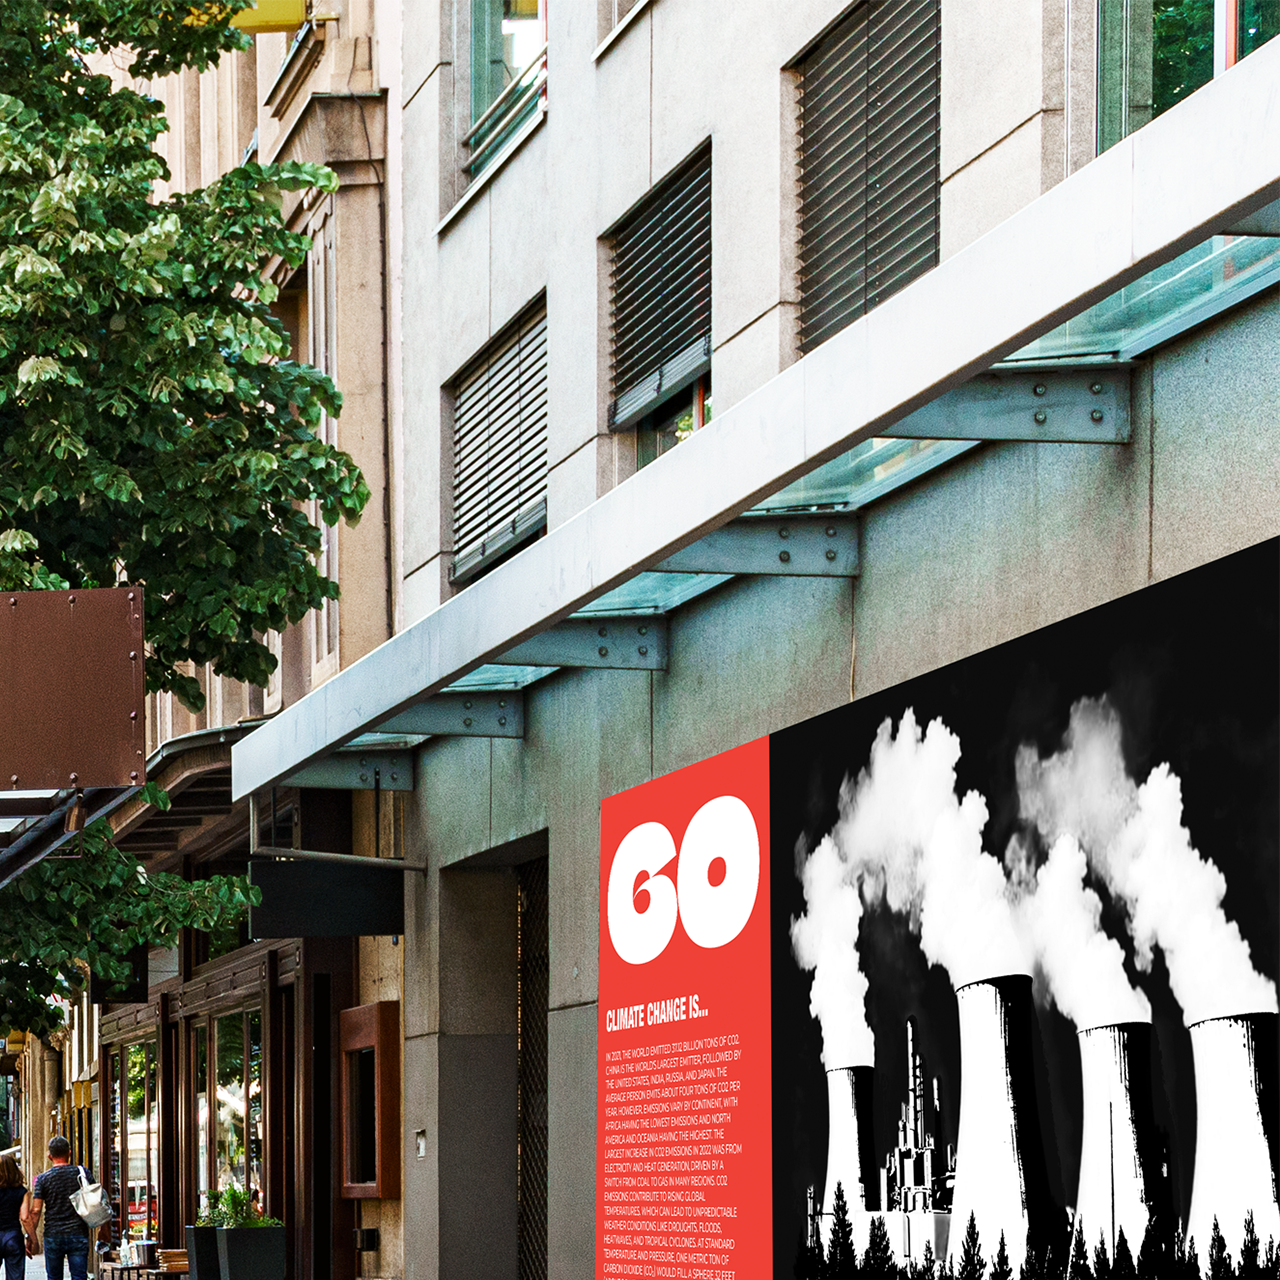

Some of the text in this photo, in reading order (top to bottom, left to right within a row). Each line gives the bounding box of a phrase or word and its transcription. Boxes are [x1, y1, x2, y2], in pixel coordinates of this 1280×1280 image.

[607, 795, 760, 965] 60
[606, 993, 709, 1032] CLIMATE CHANGE IS...
